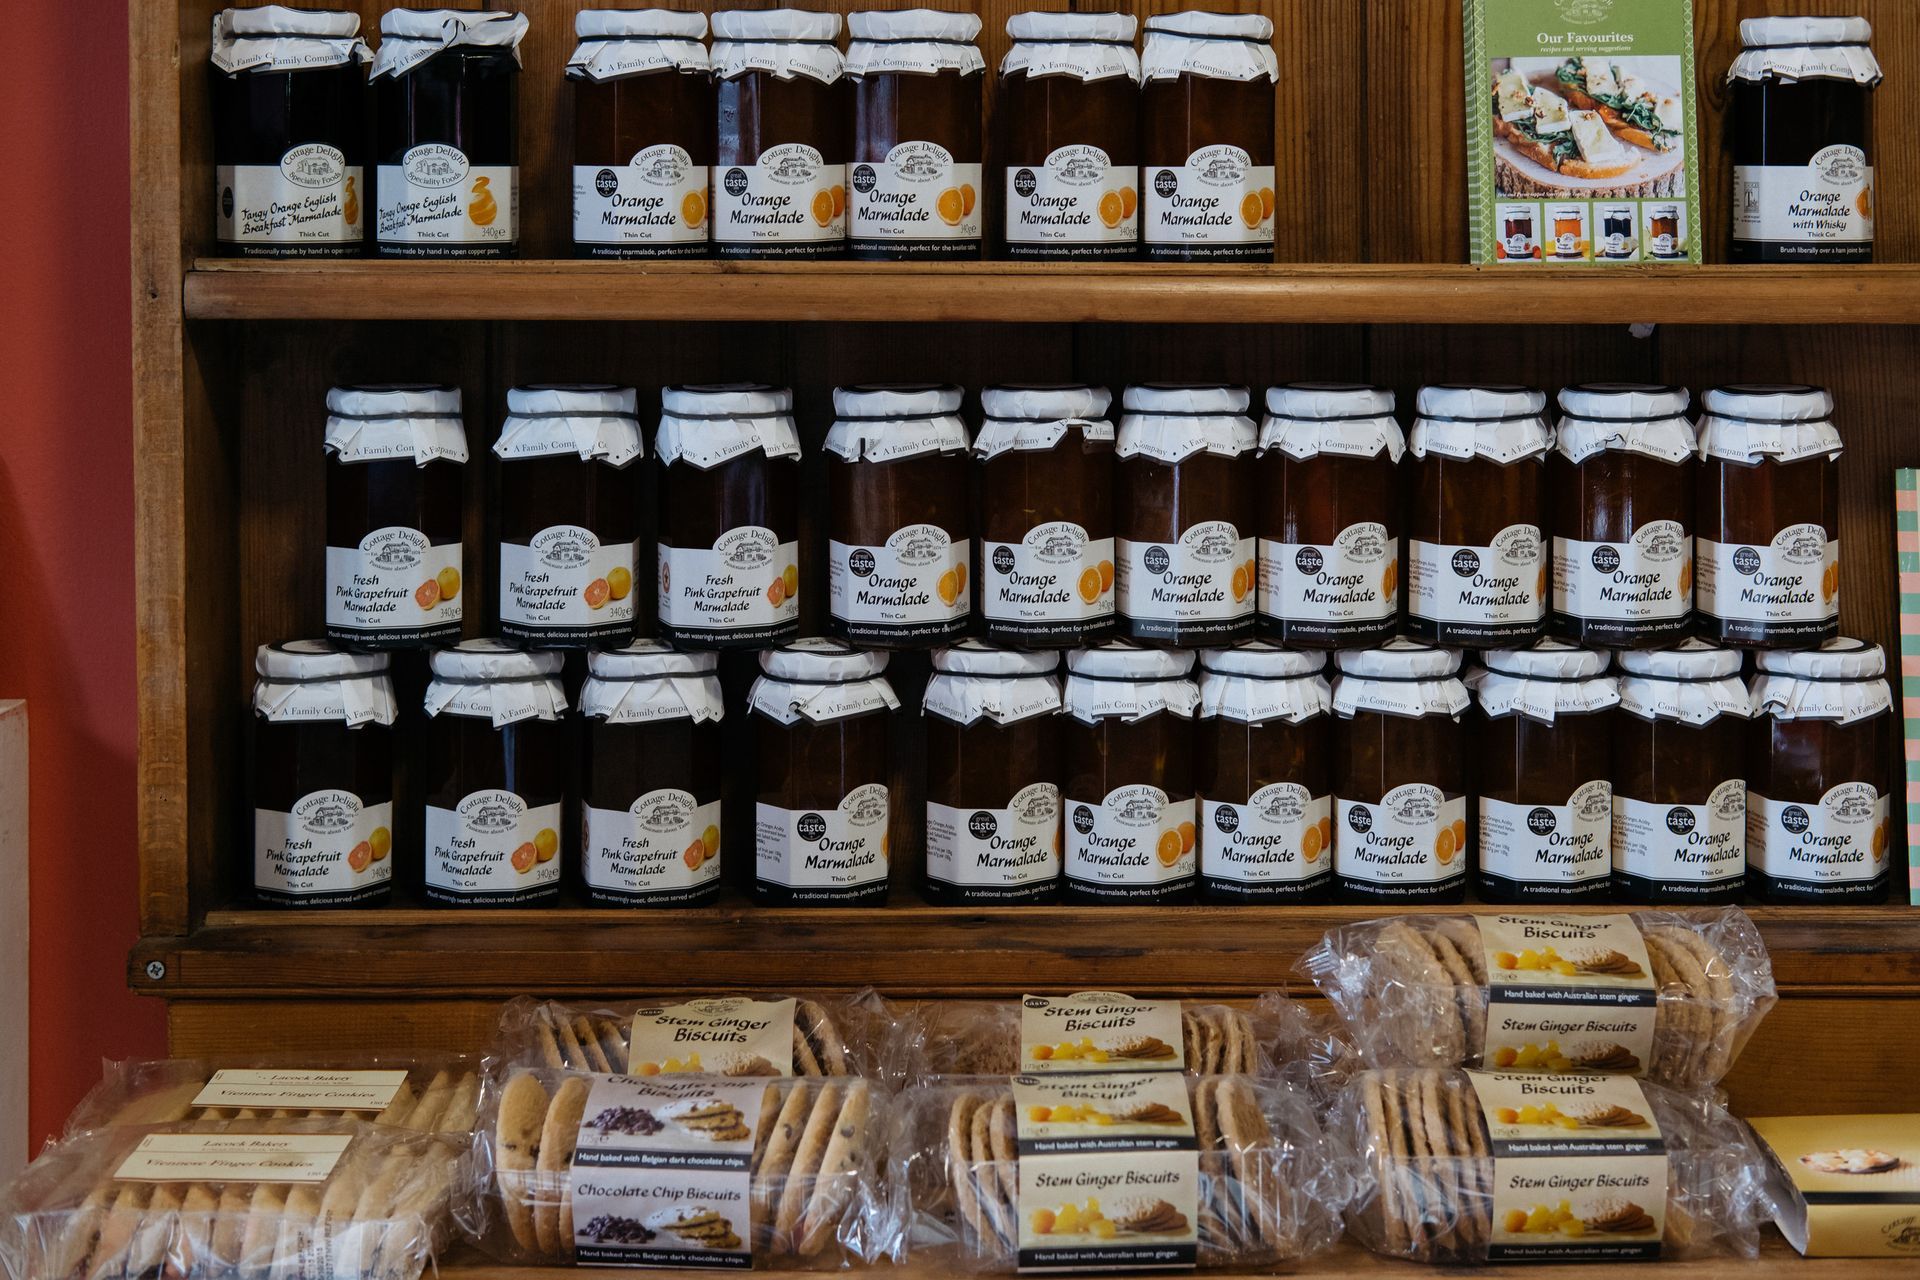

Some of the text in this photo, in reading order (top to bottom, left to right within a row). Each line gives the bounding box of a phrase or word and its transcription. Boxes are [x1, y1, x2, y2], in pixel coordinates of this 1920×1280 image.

[1537, 31, 1634, 44] Our Favourites
[1540, 45, 1561, 53] recipes
[883, 58, 924, 69] Company
[283, 145, 344, 166] Cottage Delight
[889, 142, 949, 163] Cottage Delight
[596, 178, 617, 188] taste
[725, 178, 747, 187] taste
[611, 194, 664, 211] Orange
[741, 193, 791, 209] Orange
[868, 189, 917, 207] Orange
[1030, 193, 1077, 211] Orange
[1171, 194, 1219, 211] Orange
[1799, 189, 1841, 205] Orange
[241, 193, 337, 223] Tangy Orange English
[378, 193, 457, 220] Tangy Orange English
[857, 207, 929, 222] Marmalade
[1788, 204, 1850, 216] Marmalade
[242, 206, 342, 236] Breakfast Marmalade
[379, 207, 462, 234] Breakfast Marmalade
[601, 209, 676, 225] Marmalade
[730, 209, 805, 224] Marmalade
[1019, 211, 1091, 225] Marmalade
[1160, 211, 1232, 226] Marmalade
[1792, 219, 1847, 231] with Whisky
[850, 558, 875, 568] taste
[353, 574, 379, 586] Fresh
[524, 572, 549, 583] Fresh
[705, 574, 733, 586] Fresh
[869, 574, 917, 592] Orange
[1009, 571, 1057, 589] Orange
[1163, 571, 1212, 589] Orange
[1316, 572, 1364, 590] Orange
[1472, 573, 1519, 592] Orange
[1613, 570, 1661, 588] Orange
[1753, 571, 1803, 590] Orange
[336, 586, 409, 601] Pink Grapefruit
[509, 583, 578, 599] Pink Grapefruit
[684, 587, 762, 600] Pink Grapefruit
[856, 591, 929, 606] Marmalade
[999, 588, 1070, 604] Marmalade
[1152, 588, 1224, 603] Marmalade
[1304, 588, 1376, 603] Marmalade
[1459, 590, 1530, 606] Marmalade
[1600, 587, 1672, 602] Marmalade
[1740, 588, 1815, 604] Marmalade
[343, 600, 397, 613] Marmalade
[516, 597, 566, 610] Marmalade
[694, 601, 750, 612] Marmalade
[626, 707, 655, 718] Family
[284, 838, 312, 850] Fresh
[451, 836, 476, 848] Fresh
[622, 837, 649, 849] Fresh
[818, 837, 866, 853] Orange
[990, 835, 1037, 851] Orange
[1088, 833, 1137, 851] Orange
[1232, 832, 1282, 849] Orange
[1365, 833, 1415, 850] Orange
[1549, 830, 1594, 846] Orange
[1687, 830, 1731, 846] Orange
[1803, 831, 1851, 850] Orange
[266, 850, 342, 865] Pink Grapefruit
[435, 846, 505, 864] Pink Grapefruit
[601, 848, 678, 863] Pink Grapefruit
[805, 852, 875, 869] Marmalade
[977, 850, 1048, 869] Marmalade
[1077, 848, 1149, 866] Marmalade
[1221, 847, 1295, 864] Marmalade
[1354, 848, 1428, 865] Marmalade
[1535, 846, 1603, 864] Marmalade
[1674, 846, 1740, 864] Marmalade
[1789, 847, 1864, 864] Marmalade
[274, 864, 329, 877] Marmalade
[441, 861, 492, 876] Marmalade
[610, 862, 666, 875] Marmalade
[1498, 915, 1612, 931] Stem Ginger
[1524, 927, 1596, 939] Biscuits
[1524, 990, 1545, 998] baked
[1547, 991, 1562, 999] with
[1563, 991, 1598, 1000] Australian
[1617, 993, 1640, 1003] ginger.
[1044, 1003, 1157, 1017] Stem Ginger
[655, 1015, 771, 1031] Stem Ginger
[1064, 1016, 1136, 1032] Biscuits
[1501, 1018, 1637, 1035] Stem Ginger Biscuits
[673, 1028, 748, 1043] Biscuits
[1547, 1075, 1610, 1085] Ginger
[637, 1087, 715, 1098] Biscuits
[1521, 1084, 1595, 1094] Biscuits
[578, 1153, 745, 1167] Hand baked with Belgian dark chocolate chips.
[1035, 1170, 1180, 1190] Stem Ginger Biscuits
[1509, 1174, 1649, 1192] Stem Ginger Biscuits
[578, 1184, 741, 1201] Chocolate Chip Biscuits
